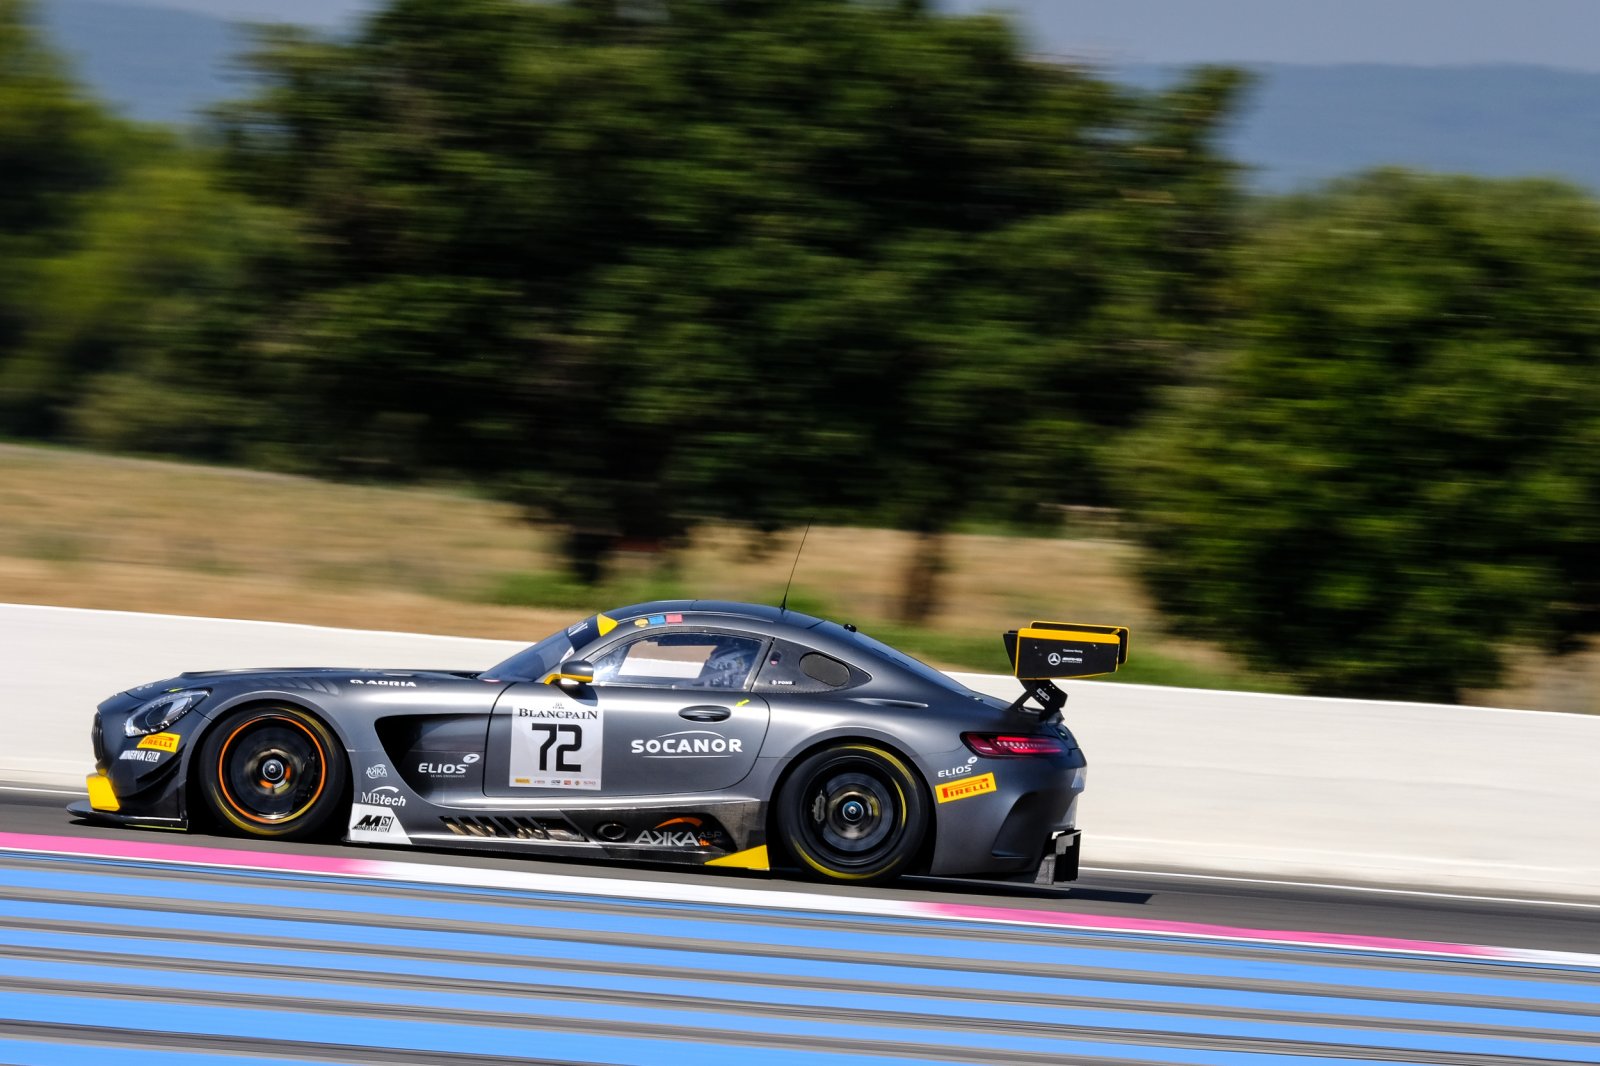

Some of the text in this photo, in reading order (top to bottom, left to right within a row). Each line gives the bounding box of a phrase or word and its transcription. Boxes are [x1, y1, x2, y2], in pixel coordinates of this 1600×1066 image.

[518, 707, 599, 720] BLANCPAIN
[531, 722, 583, 773] 72
[630, 738, 744, 754] SOCANOR
[417, 762, 467, 774] ELIOS
[937, 764, 973, 778] ELIOS
[942, 777, 989, 798] PIRELLI
[360, 791, 407, 807] MBtech
[634, 829, 701, 847] AKKA
